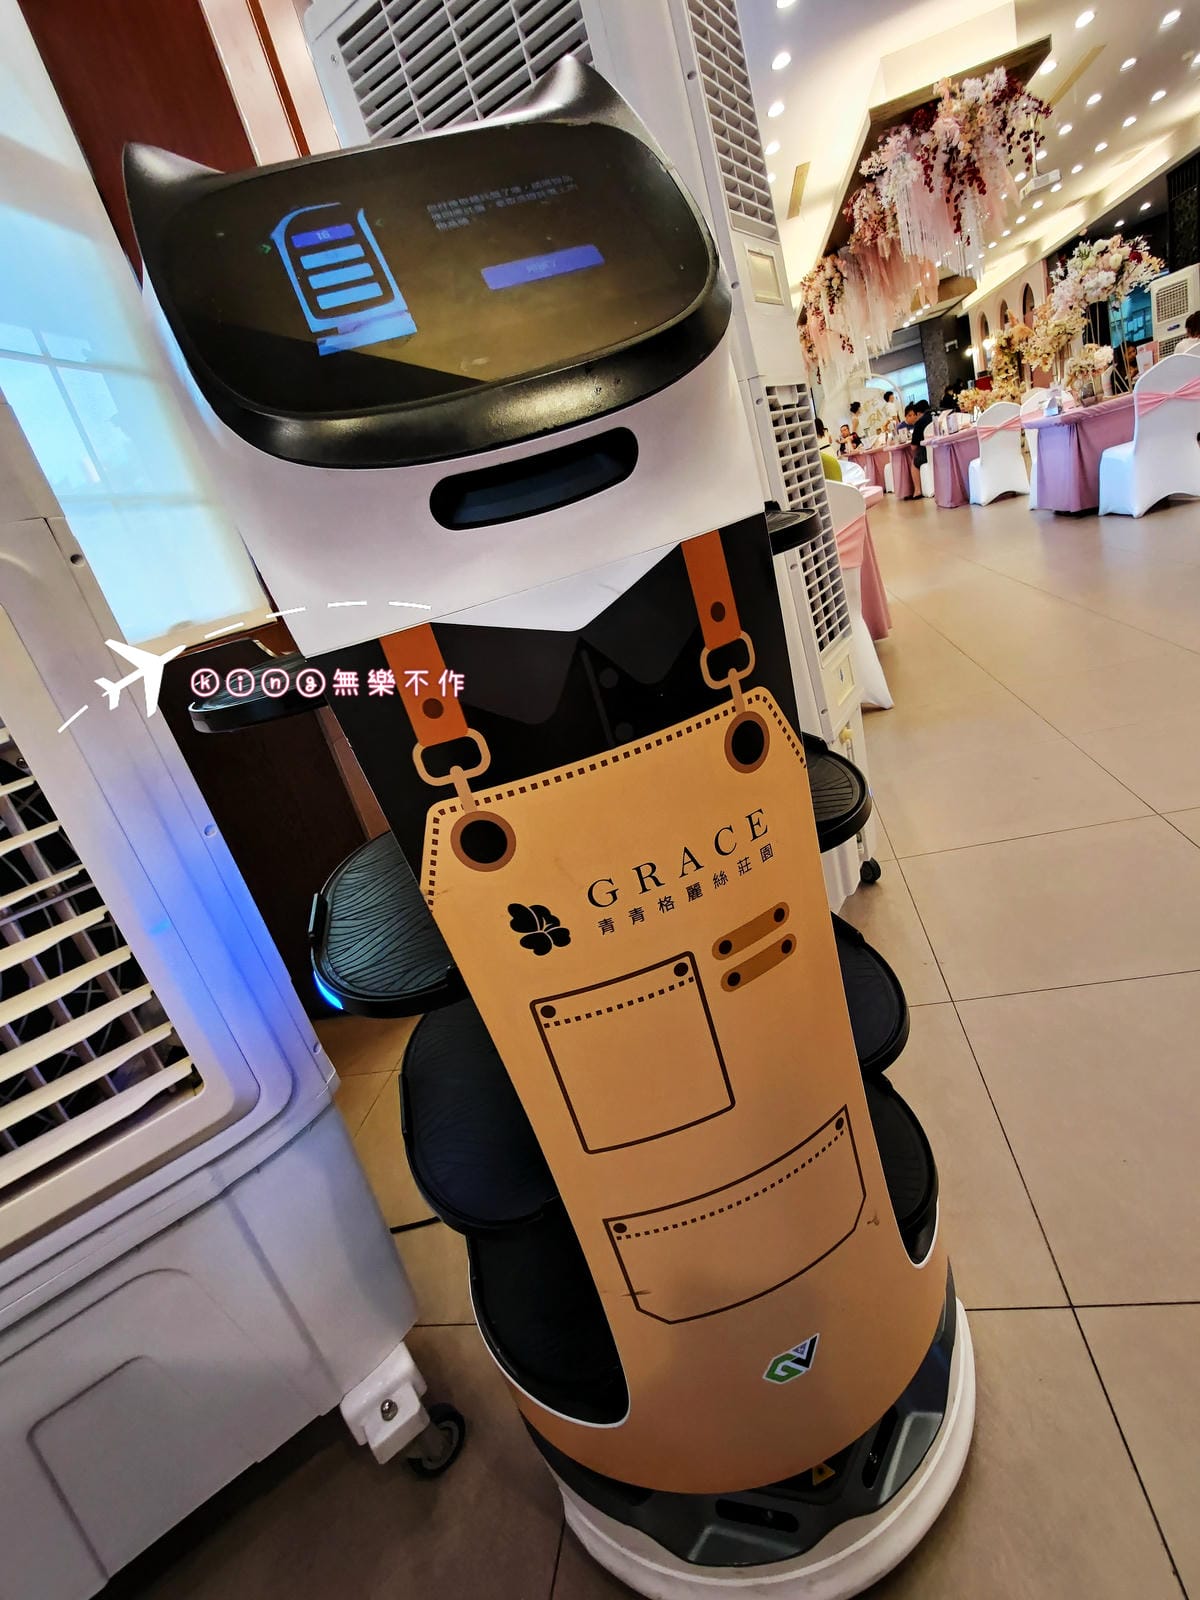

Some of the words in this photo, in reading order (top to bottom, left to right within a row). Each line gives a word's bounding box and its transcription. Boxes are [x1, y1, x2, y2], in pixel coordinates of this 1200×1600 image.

[587, 808, 769, 908] GRACE
[598, 843, 774, 936] 青青格麗絲莊園
